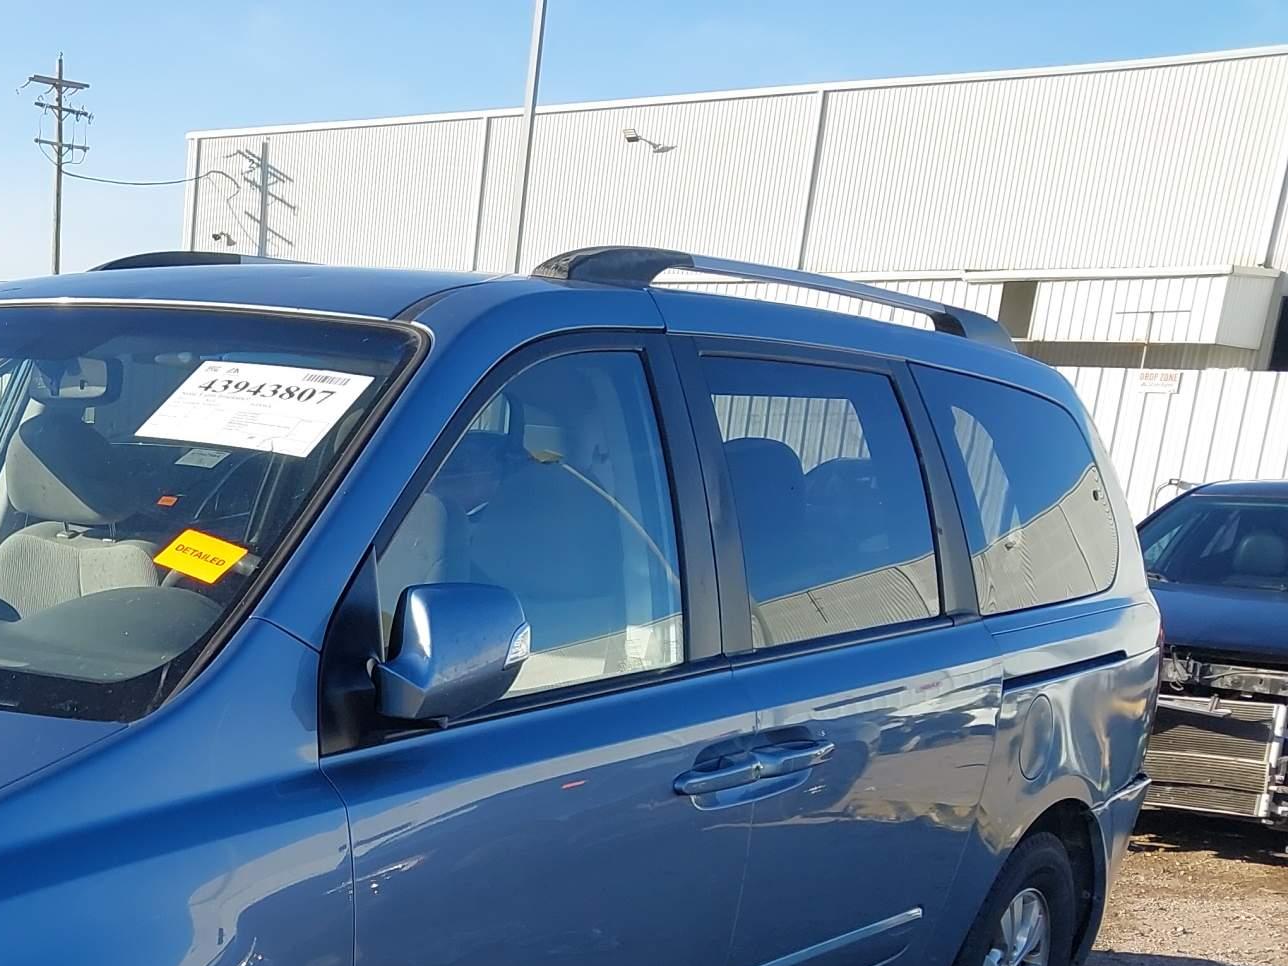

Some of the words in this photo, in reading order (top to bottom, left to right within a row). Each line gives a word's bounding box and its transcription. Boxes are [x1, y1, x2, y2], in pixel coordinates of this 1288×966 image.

[1160, 372, 1178, 382] ZONE
[198, 378, 336, 405] 43943807
[175, 543, 226, 568] DETAILED
